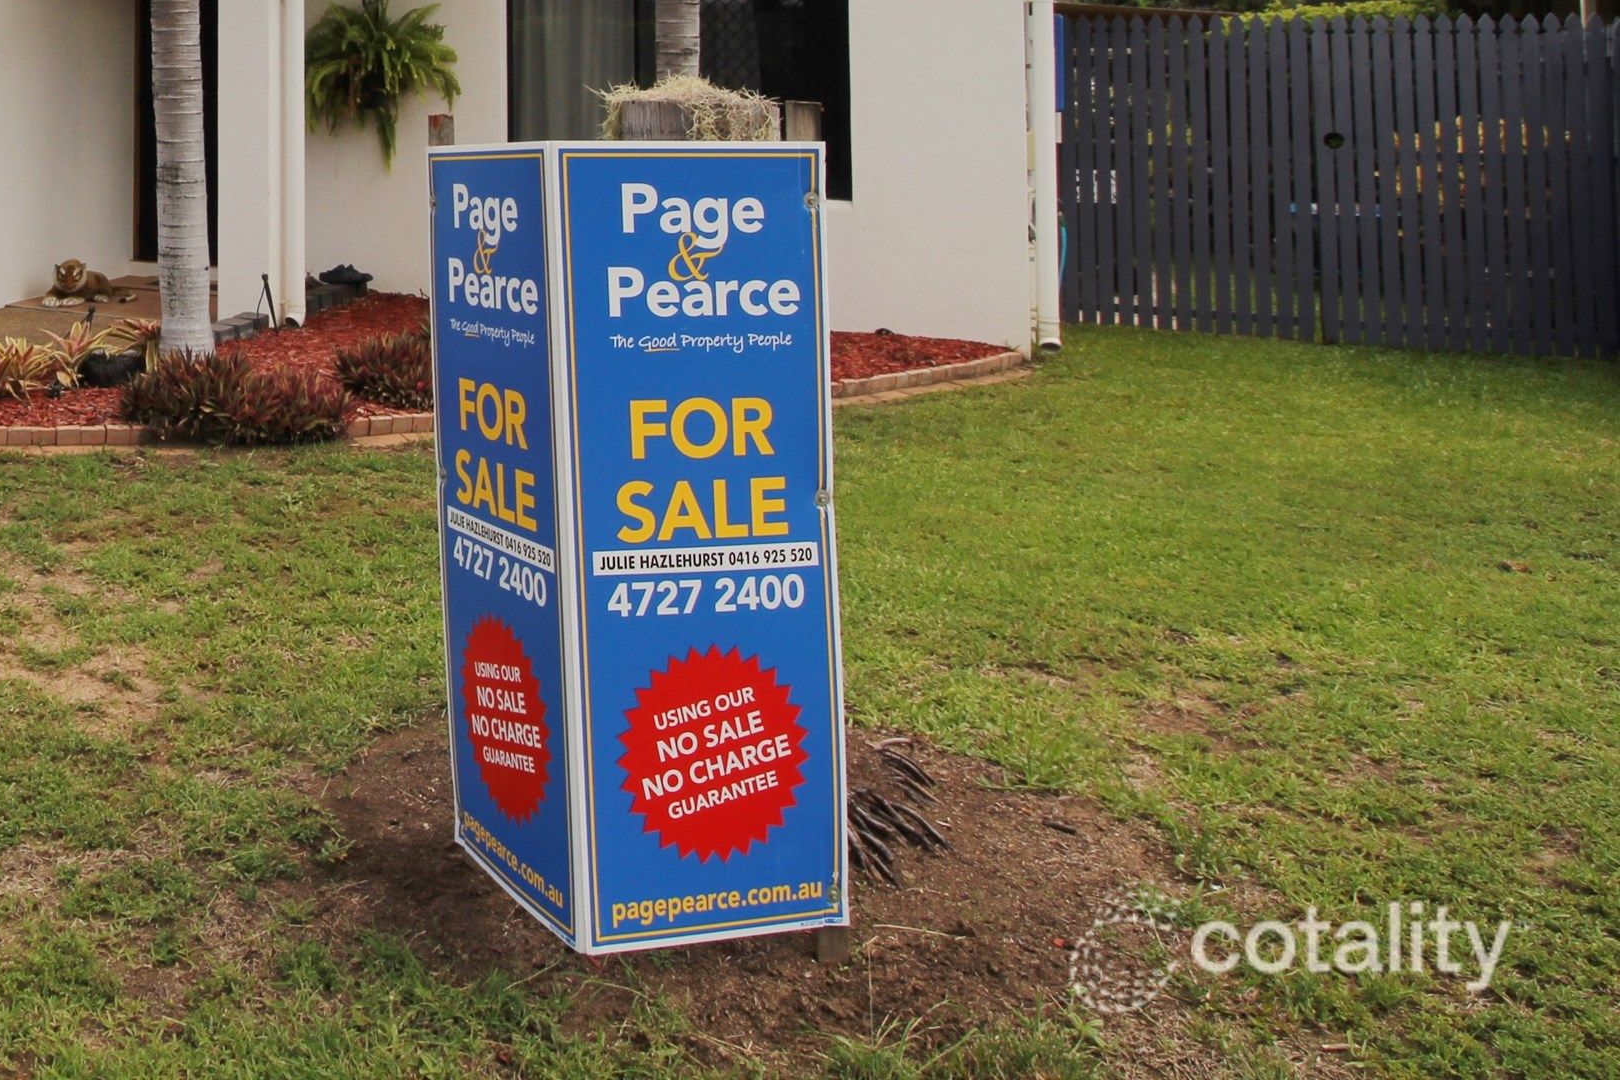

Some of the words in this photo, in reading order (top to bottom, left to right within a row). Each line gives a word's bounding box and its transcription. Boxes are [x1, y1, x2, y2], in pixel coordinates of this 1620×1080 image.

[452, 183, 518, 245] Page
[621, 183, 765, 249] Page
[473, 229, 498, 275] &
[668, 231, 723, 282] &
[448, 258, 538, 315] Pearce
[607, 266, 800, 318] Pearce
[480, 324, 510, 347] Property
[511, 329, 535, 348] People
[610, 334, 634, 348] The
[638, 333, 678, 350] Good
[681, 334, 743, 353] Property
[747, 331, 792, 350] People
[458, 377, 528, 450] FOR
[629, 396, 775, 460] FOR
[455, 449, 537, 532] SALE
[616, 476, 789, 543] SALE
[450, 511, 465, 529] JULIE
[466, 518, 504, 548] HAZLEHURST
[505, 533, 521, 554] 0416
[522, 543, 536, 561] 925
[538, 550, 551, 567] 520
[600, 555, 635, 570] JULIE
[640, 552, 725, 569] HAZLEHURST
[729, 551, 759, 566] 0416
[763, 549, 786, 564] 925
[791, 547, 812, 562] 520
[453, 536, 493, 580] 4727
[499, 556, 546, 607] 2400
[607, 579, 702, 617] 4727
[714, 573, 805, 612] 2400
[474, 661, 499, 679] USING
[500, 665, 521, 683] OUR
[476, 686, 494, 708] NO
[496, 689, 527, 714] SALE
[654, 700, 711, 730] USING
[715, 686, 755, 711] OUR
[471, 714, 489, 737] NO
[491, 718, 541, 748] CHARGE
[656, 731, 698, 763] NO
[703, 710, 764, 748] SALE
[483, 746, 535, 773] GUARANTEE
[642, 769, 684, 800] NO
[689, 733, 792, 784] CHARGE
[668, 770, 779, 819] GUARANTEE
[463, 810, 563, 908] pagepearce.com.au
[612, 878, 822, 928] pagepearce.com.au
